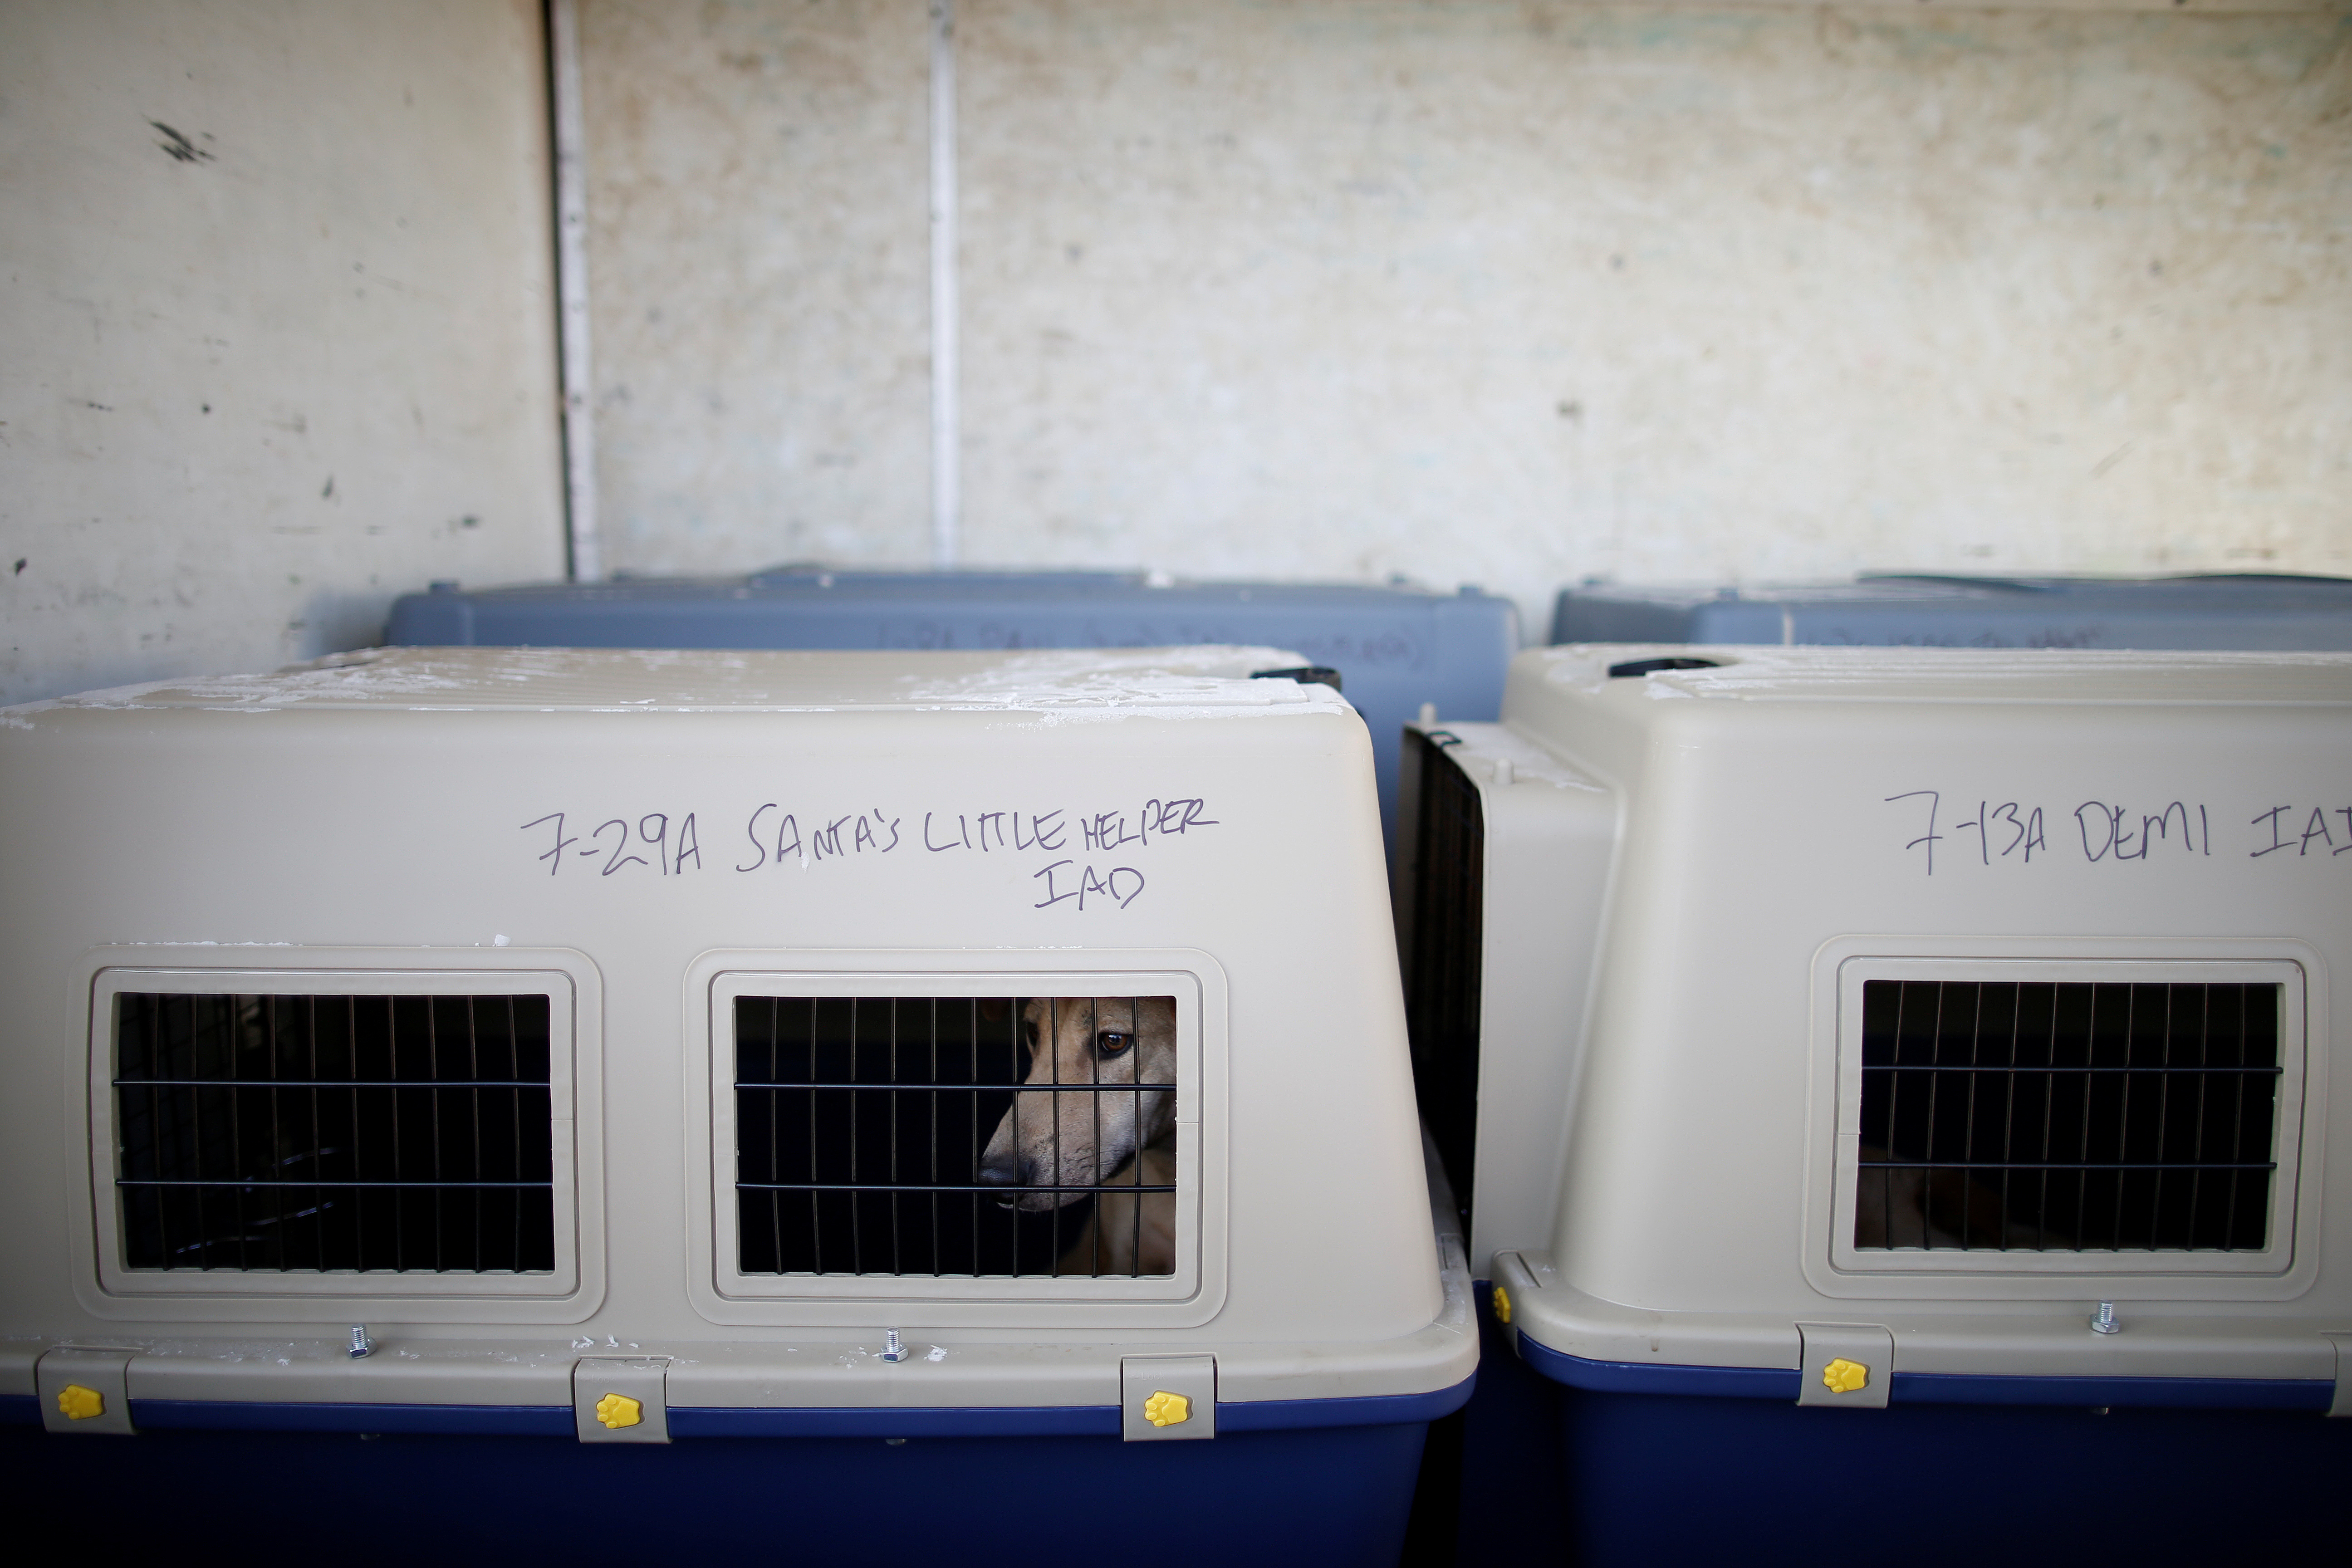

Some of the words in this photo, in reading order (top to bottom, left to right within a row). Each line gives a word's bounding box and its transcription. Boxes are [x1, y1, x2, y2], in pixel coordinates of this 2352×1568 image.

[520, 813, 701, 876] 7-29A
[735, 804, 900, 872] SANTA'S
[924, 808, 1066, 852] LITTLE
[1080, 799, 1220, 851] HELPER
[1884, 791, 2046, 876] 7-13A
[2074, 801, 2210, 862] DEMI
[1033, 859, 1145, 911] IAD
[592, 1374, 615, 1383] Lock
[1141, 1371, 1166, 1381] Lock
